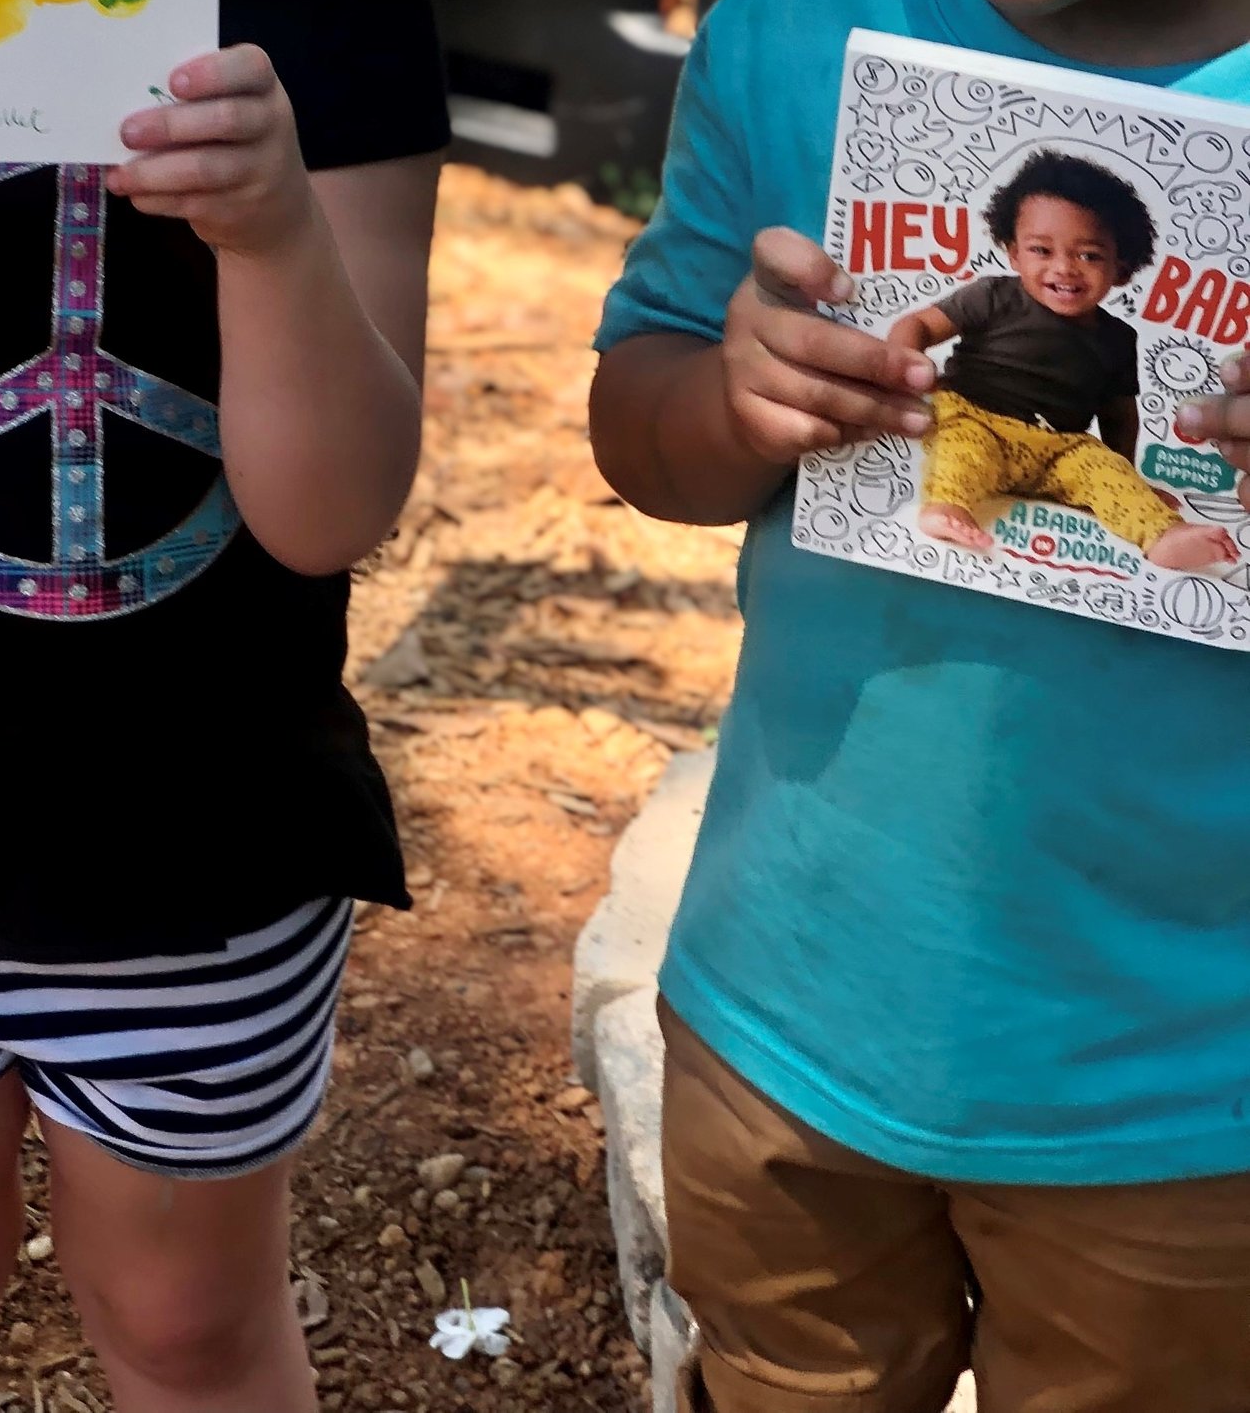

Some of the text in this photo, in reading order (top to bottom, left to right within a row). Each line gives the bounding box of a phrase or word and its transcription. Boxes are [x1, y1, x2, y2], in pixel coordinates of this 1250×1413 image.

[1155, 463, 1219, 488] PIPPINS
[1010, 502, 1027, 525] A
[995, 518, 1031, 549] DAY
